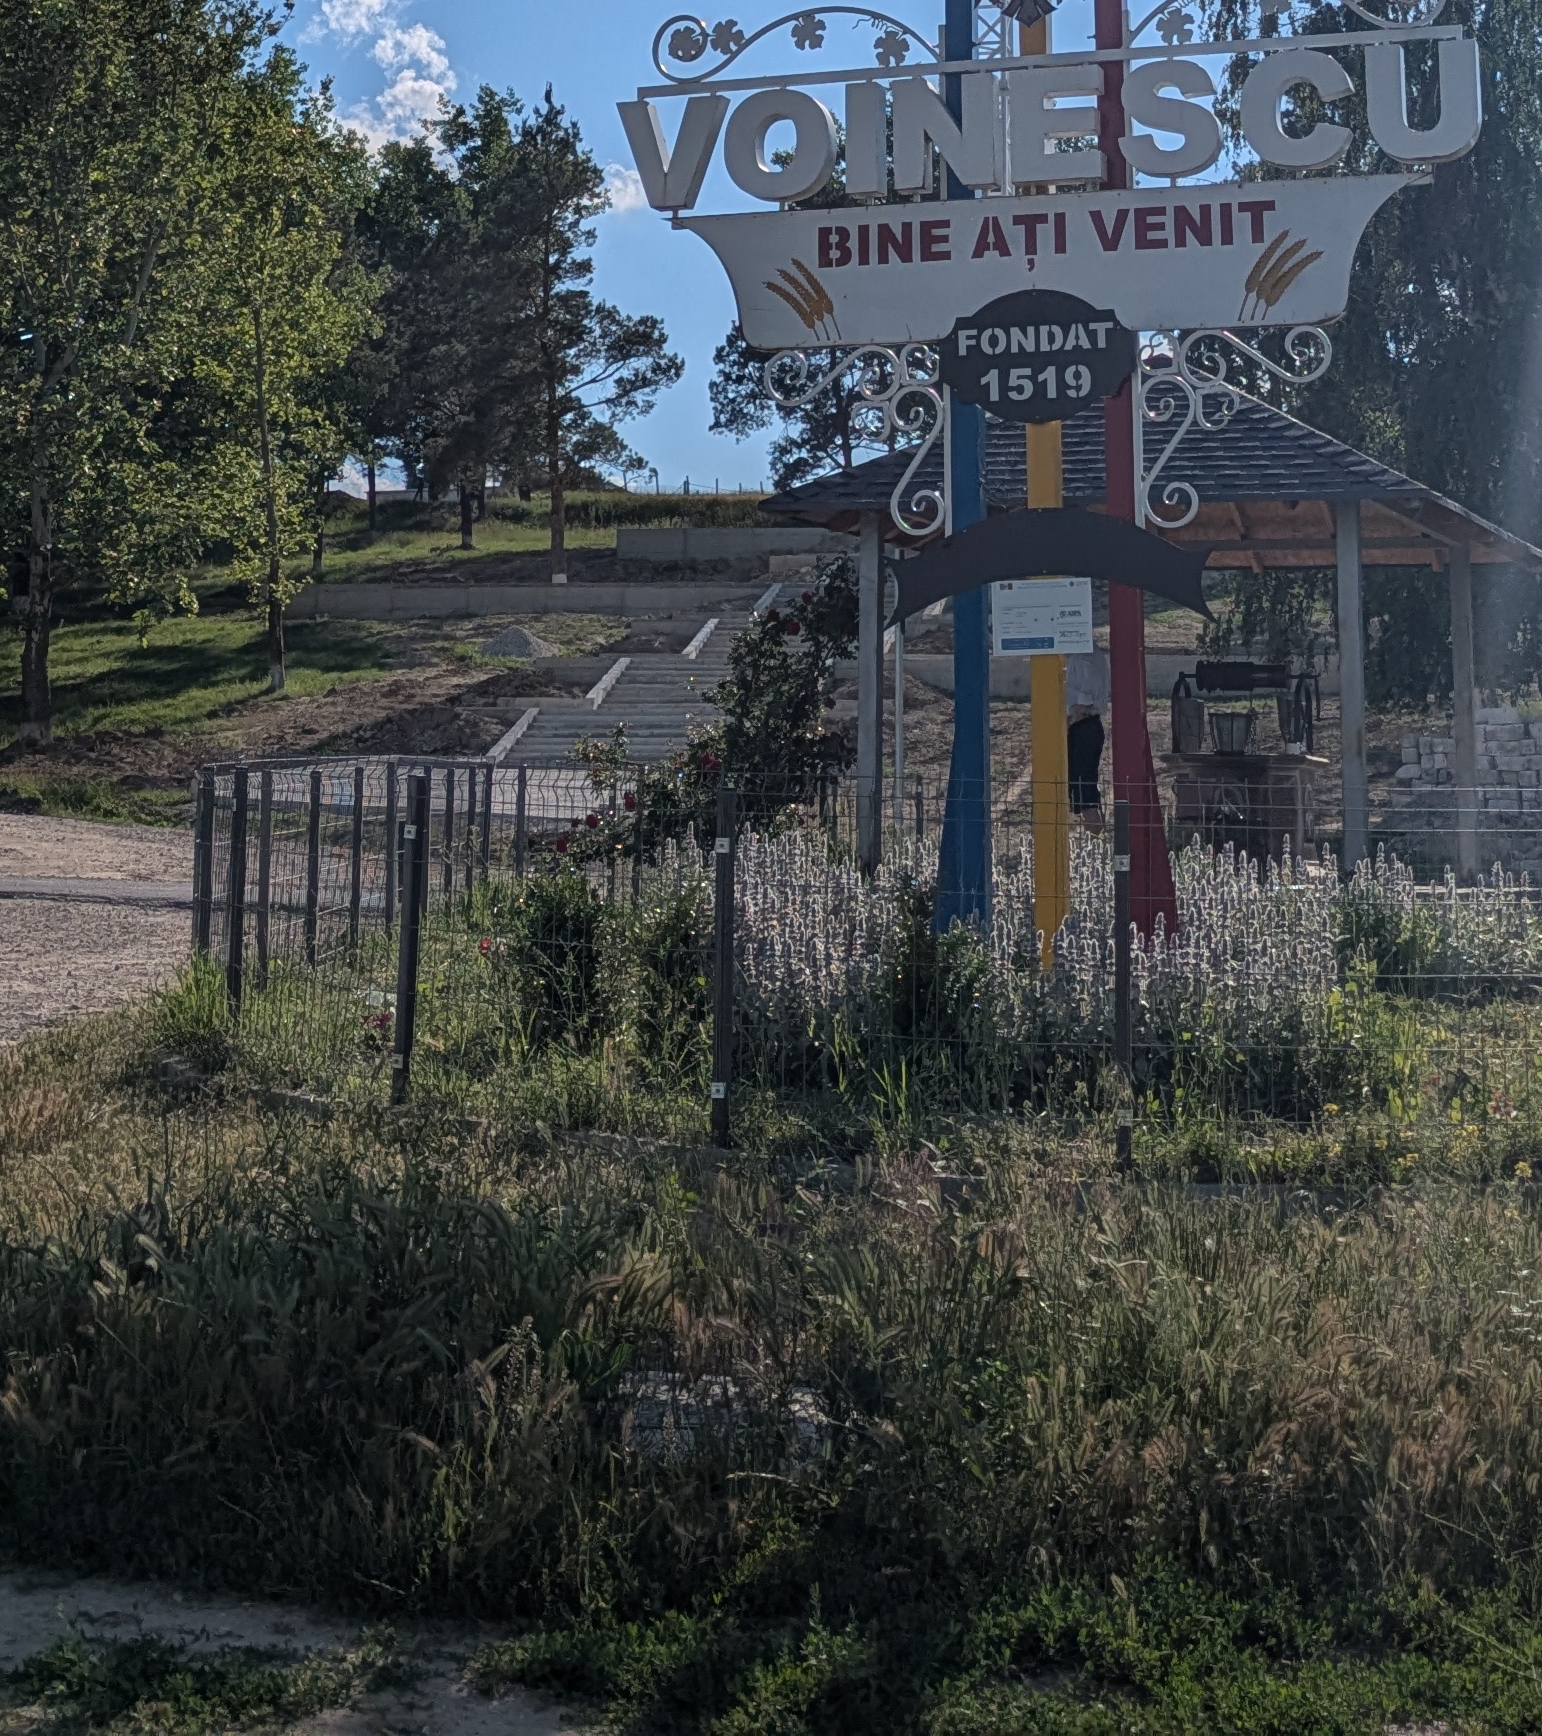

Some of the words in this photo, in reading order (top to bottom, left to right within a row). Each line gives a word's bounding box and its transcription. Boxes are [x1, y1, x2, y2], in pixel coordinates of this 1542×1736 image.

[616, 38, 1482, 212] VOINESCU
[817, 218, 952, 269] BINE
[1088, 199, 1276, 253] VENIT
[957, 321, 1114, 357] FONDAT
[980, 364, 1092, 402] 1519
